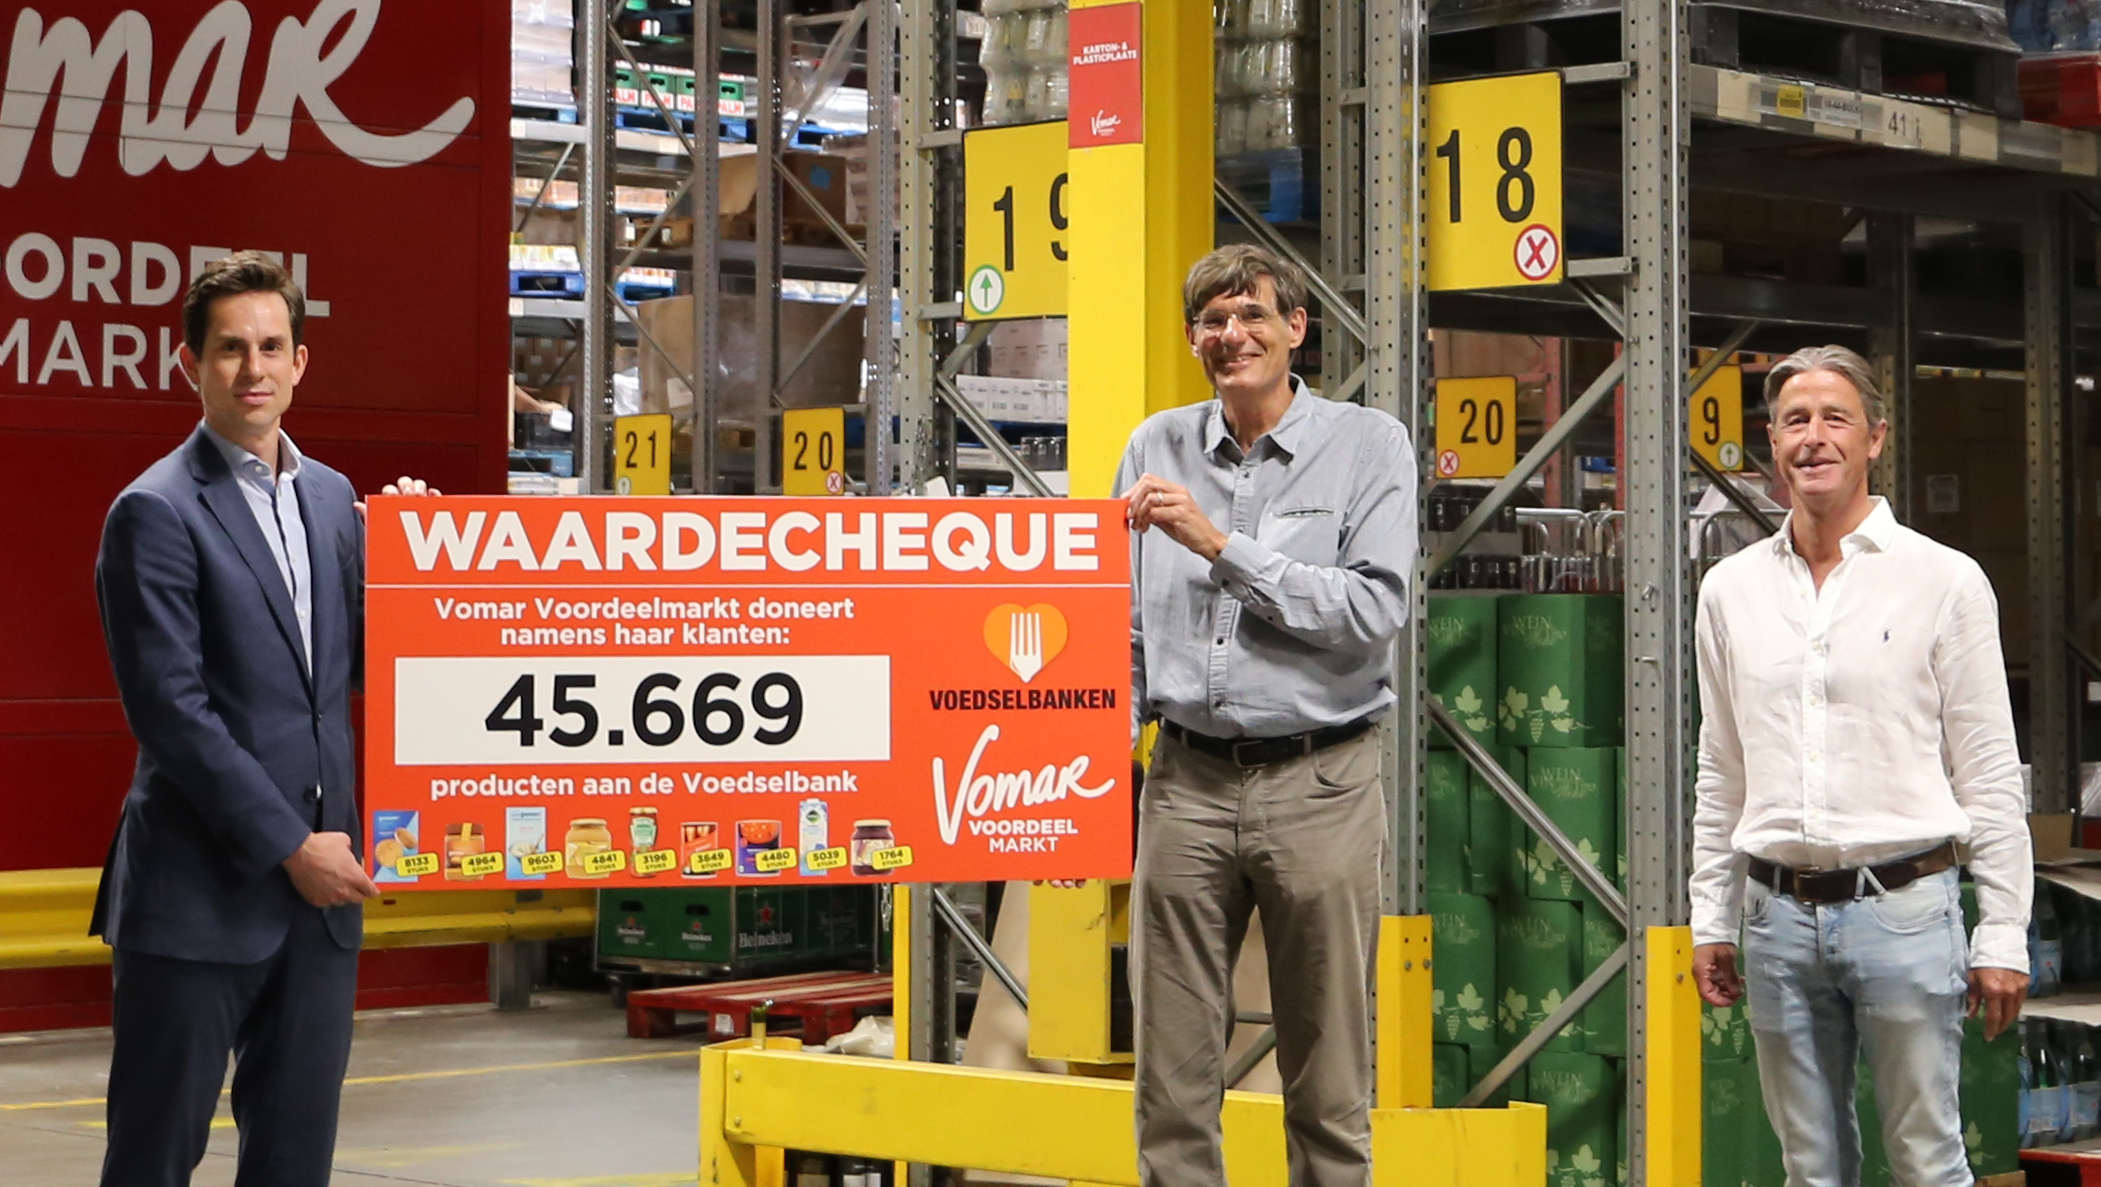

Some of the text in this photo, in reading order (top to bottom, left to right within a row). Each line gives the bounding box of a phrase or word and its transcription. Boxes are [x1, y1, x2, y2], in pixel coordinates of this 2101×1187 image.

[1121, 41, 1128, 51] &
[1073, 50, 1138, 65] PLASTICPLAATS
[1436, 127, 1535, 223] 18
[1459, 399, 1504, 446] 20
[626, 431, 657, 469] 21
[794, 431, 834, 471] 20
[399, 510, 1099, 572] WAARDECHEQUE
[434, 597, 854, 620] Vomar Voordeelmarkt doneert
[501, 622, 791, 645] namens haar klanten:
[929, 688, 1116, 711] VOEDSELBANKEN
[484, 672, 804, 748] 45.669
[430, 770, 859, 801] producten aan de Voedselbank
[932, 724, 1116, 845] Vomar
[968, 819, 1079, 836] VOORDEEL
[989, 837, 1059, 853] MARKT
[405, 856, 429, 867] 8133
[468, 855, 496, 866] 4964
[527, 854, 556, 866] 9603
[591, 854, 617, 865] 4841
[643, 853, 668, 864] 3196
[697, 852, 724, 863] 3649
[762, 851, 790, 862] 4480
[812, 850, 840, 861] 5039
[879, 849, 903, 860] 1764
[738, 931, 794, 949] Heineken
